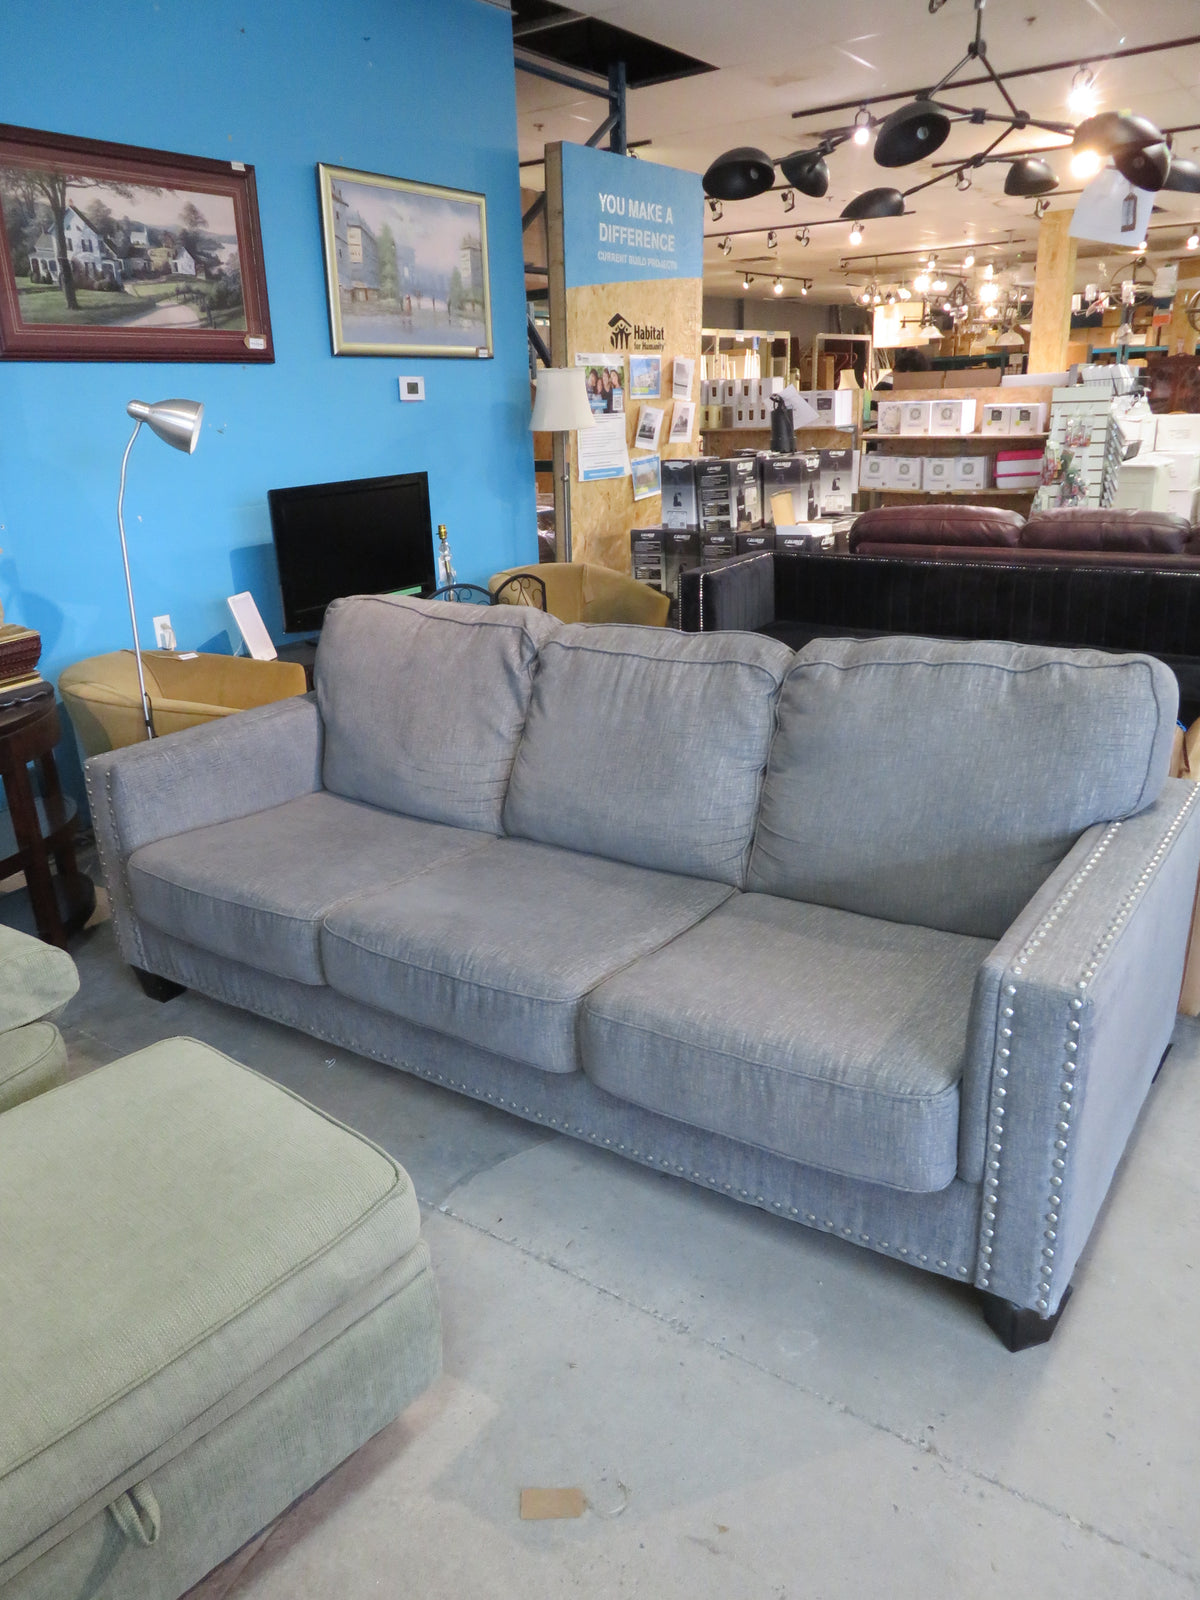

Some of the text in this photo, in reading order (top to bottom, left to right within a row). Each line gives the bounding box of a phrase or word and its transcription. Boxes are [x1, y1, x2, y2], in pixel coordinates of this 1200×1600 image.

[599, 192, 674, 225] YOU MAKE A
[599, 222, 675, 252] DIFFERENCE
[597, 250, 627, 264] CURRENT
[633, 324, 665, 341] Habitat
[641, 341, 665, 352] Humanity
